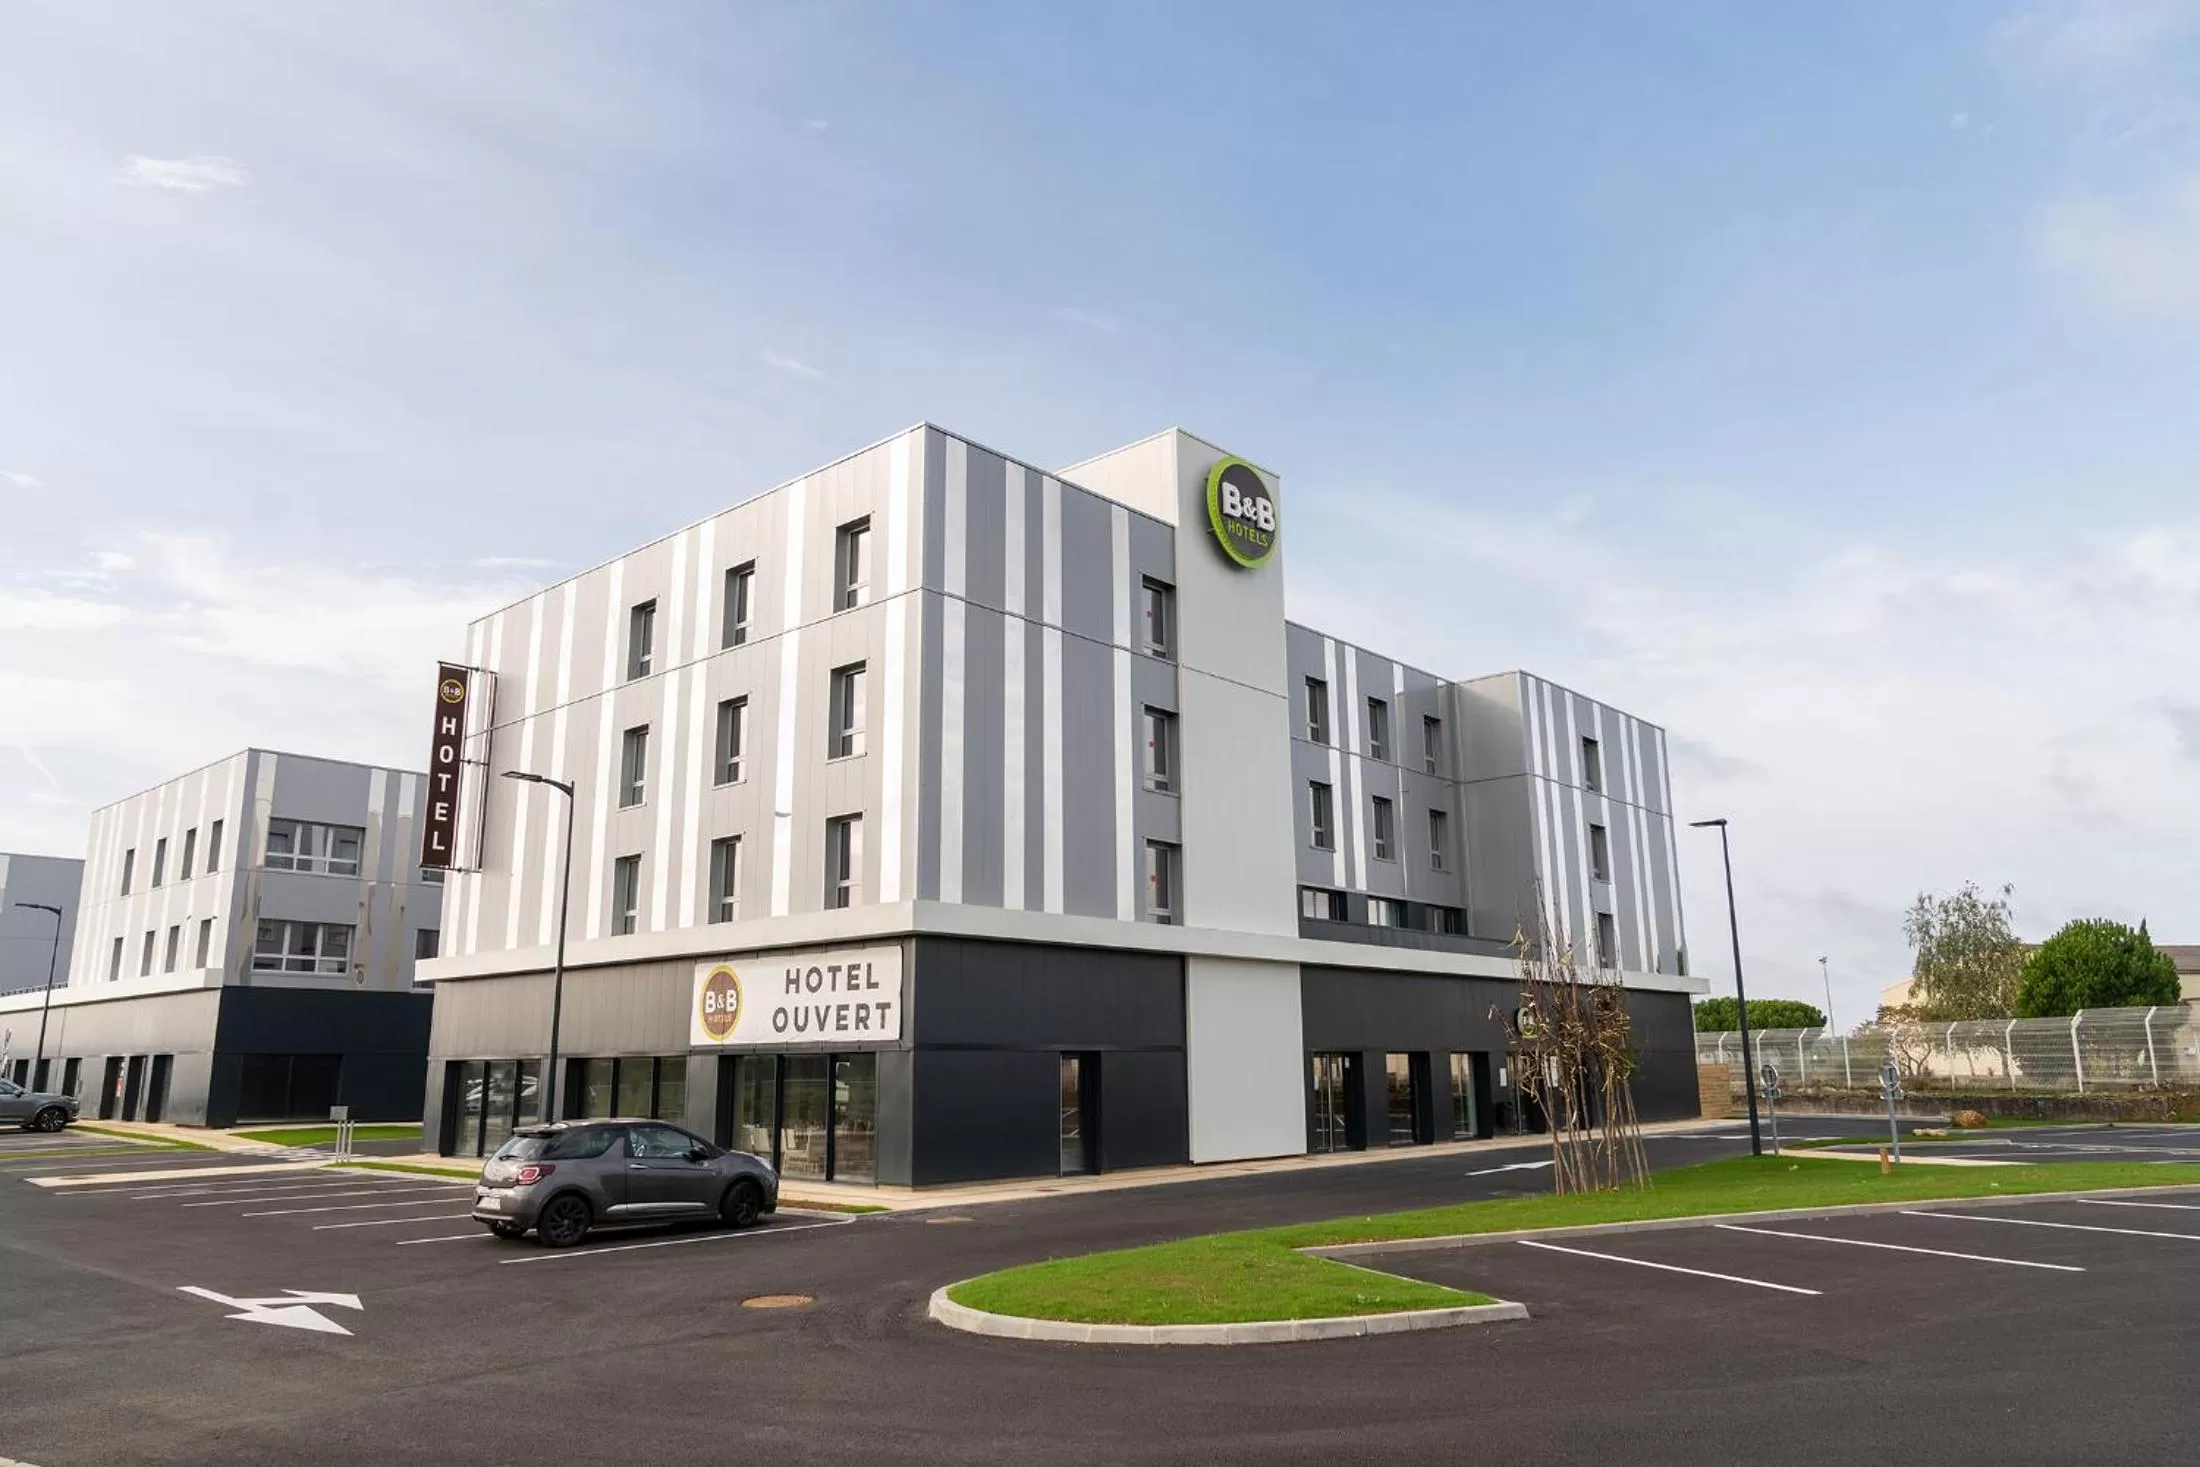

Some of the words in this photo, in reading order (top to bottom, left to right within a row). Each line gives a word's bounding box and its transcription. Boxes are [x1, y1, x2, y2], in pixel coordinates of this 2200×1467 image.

[1222, 482, 1276, 532] B&B
[1229, 519, 1268, 547] HOTELS
[432, 716, 456, 850] HOTEL
[785, 963, 879, 994] HOTEL
[704, 989, 737, 1013] B&B
[773, 1002, 891, 1033] OUVERT
